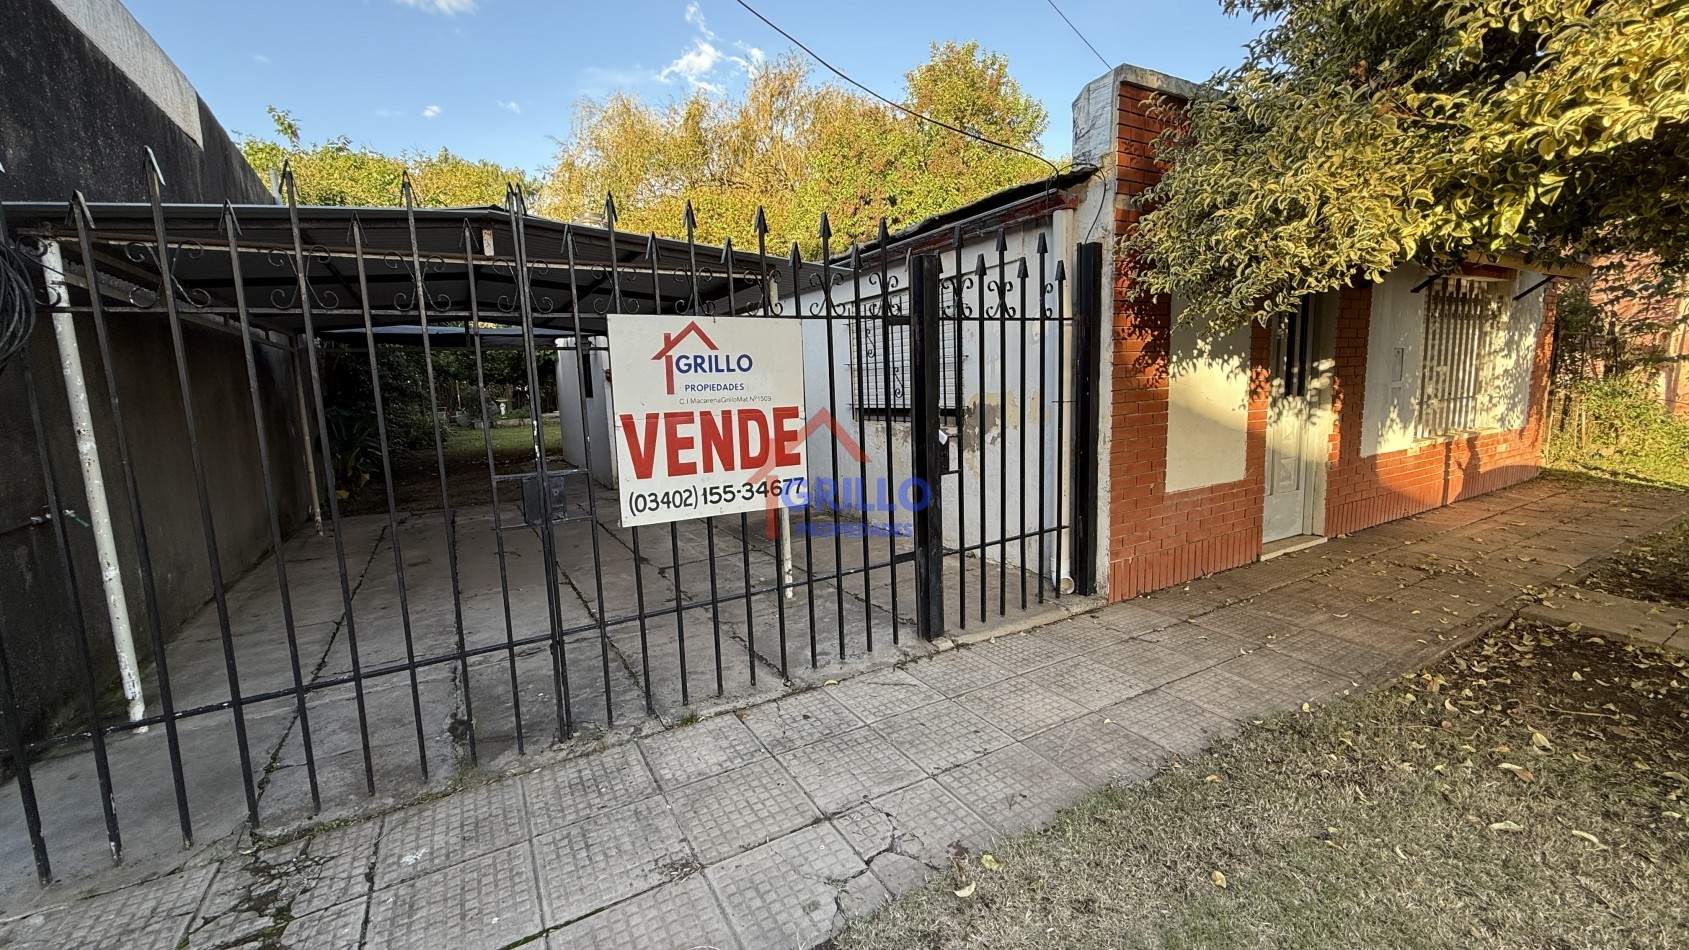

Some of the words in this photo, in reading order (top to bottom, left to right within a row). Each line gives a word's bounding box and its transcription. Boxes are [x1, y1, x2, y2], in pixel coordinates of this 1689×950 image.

[675, 353, 753, 374] GRILLO
[684, 383, 745, 392] PROPIEDADES
[619, 406, 801, 480] VENDE
[629, 485, 698, 516] (03402)
[701, 477, 805, 505] 155-34677
